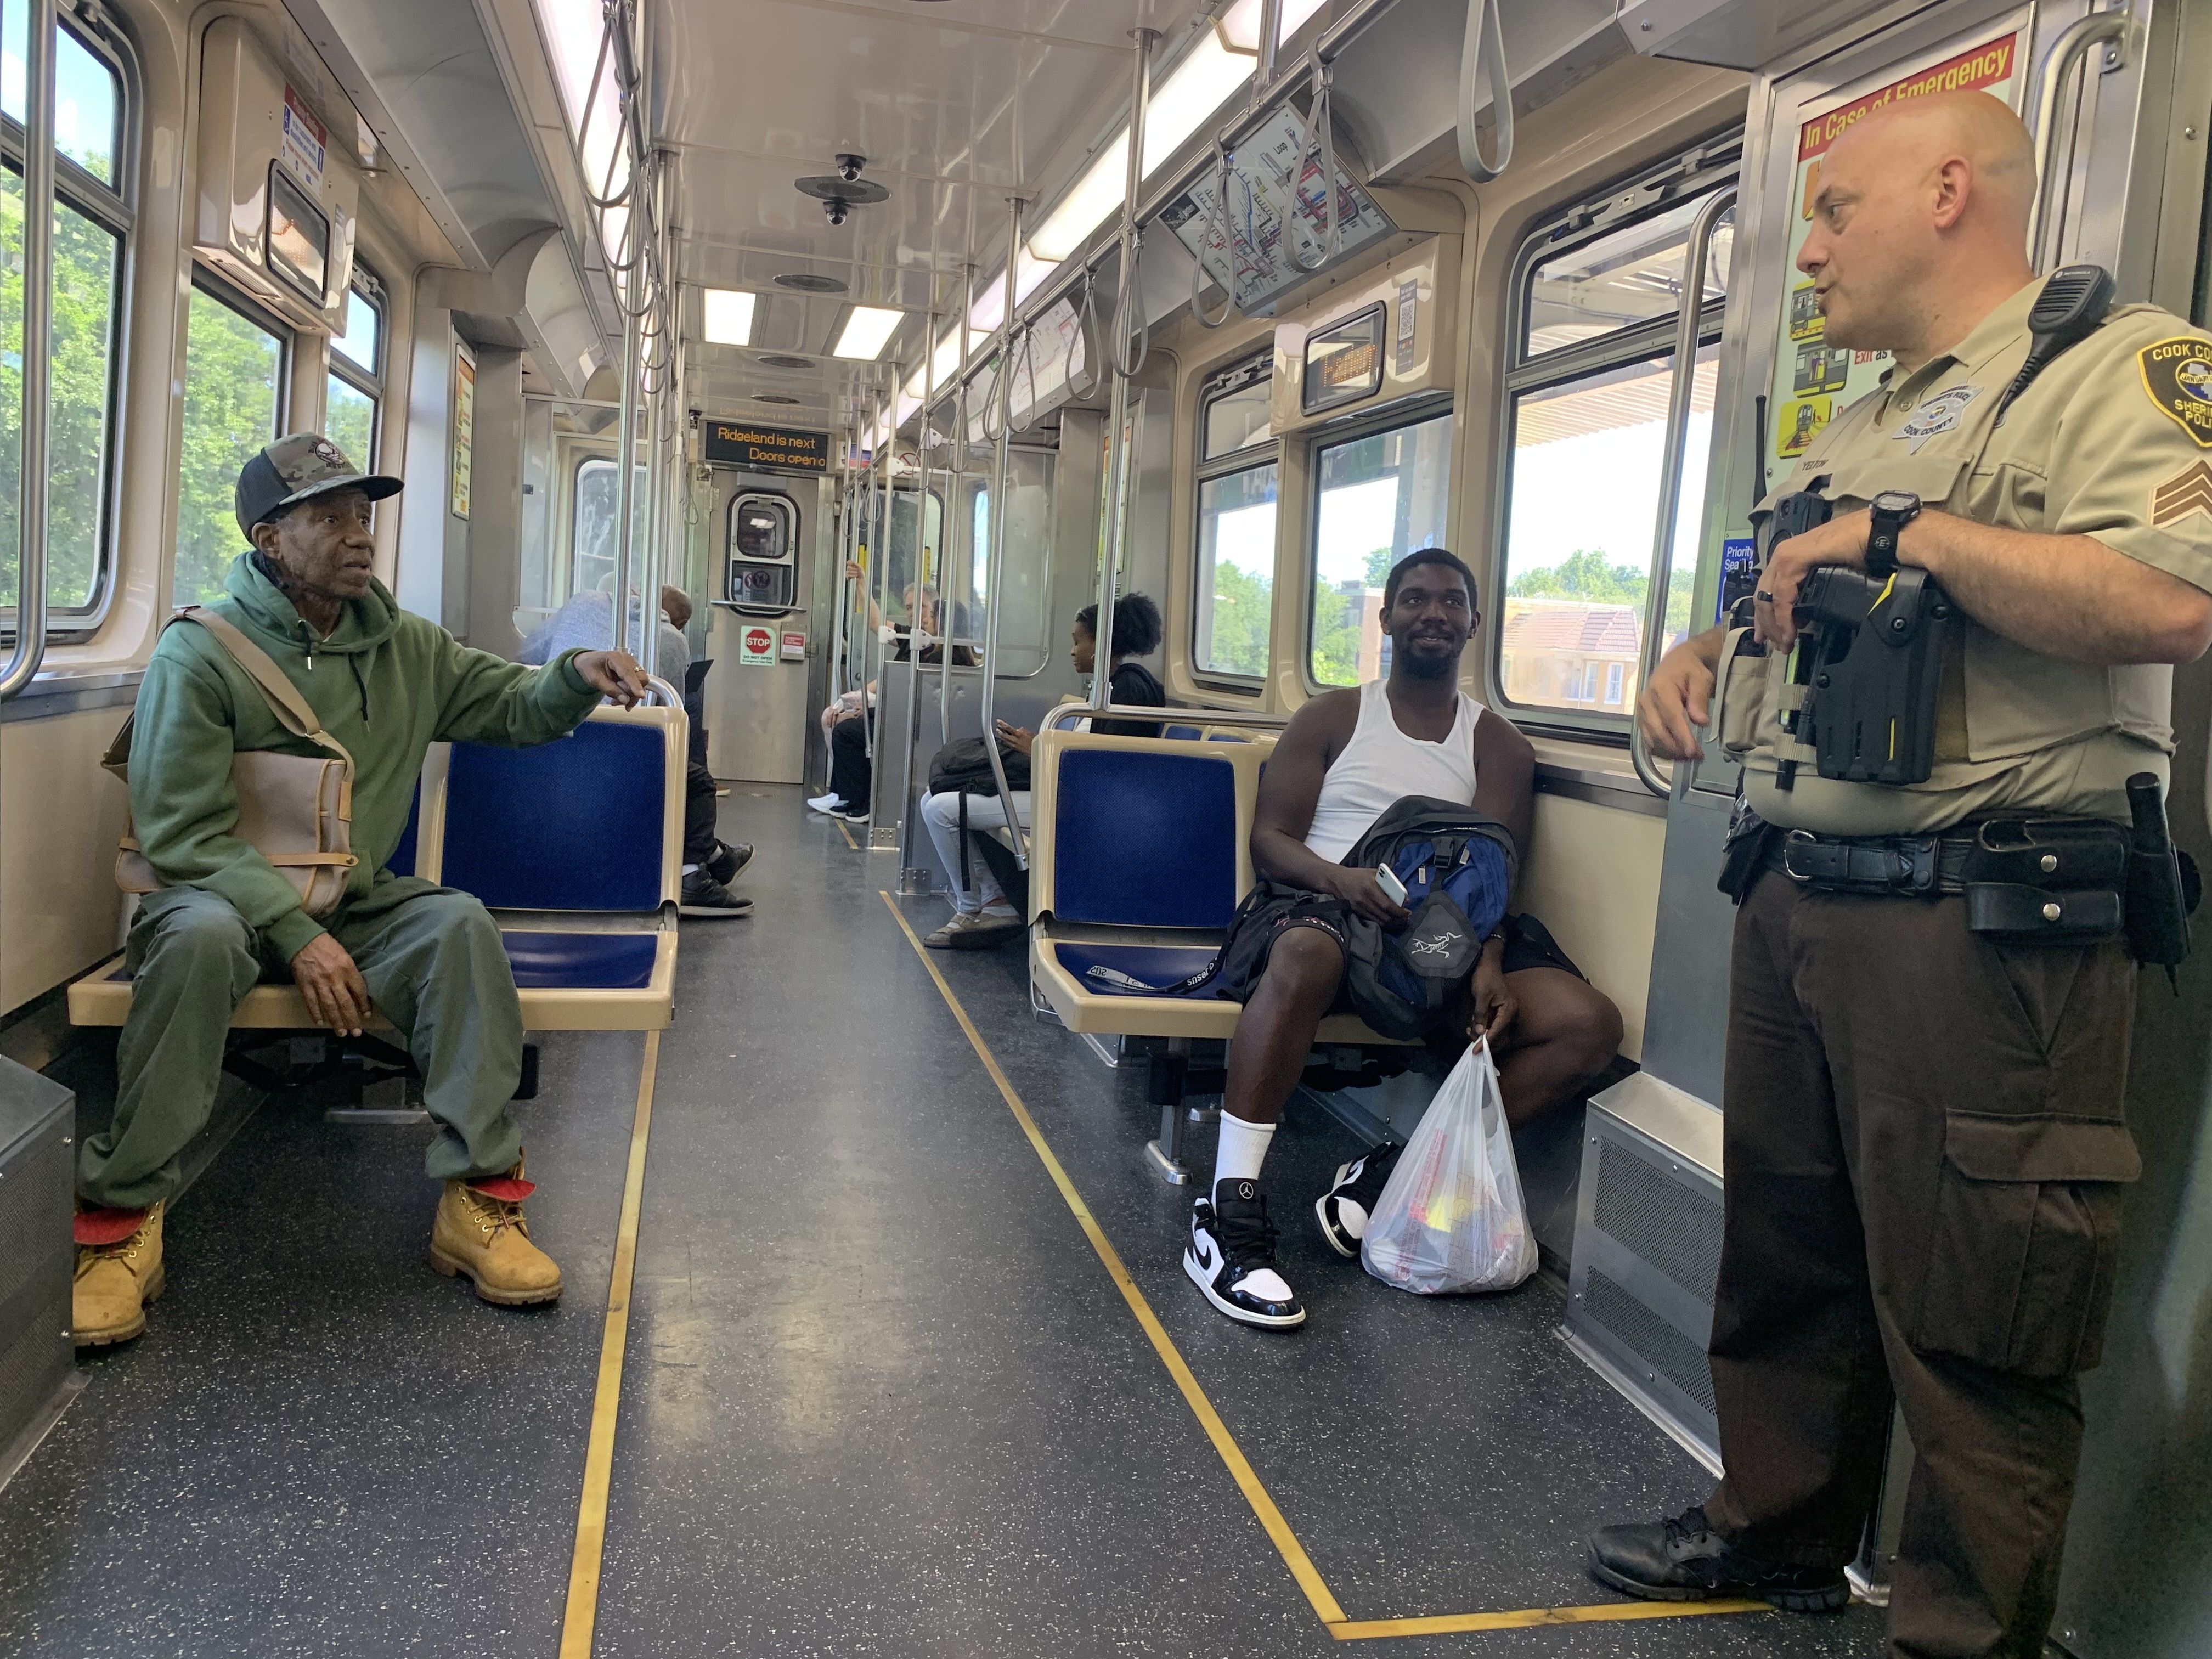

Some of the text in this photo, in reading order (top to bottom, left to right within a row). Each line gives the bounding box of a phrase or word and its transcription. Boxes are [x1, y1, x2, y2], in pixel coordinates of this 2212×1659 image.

[1805, 45, 2010, 149] In Case of Emergency
[1273, 142, 1288, 155] Loop
[1876, 350, 1887, 360] as
[2153, 344, 2191, 360] COOK
[1904, 416, 1954, 436] COOK COUNTY
[718, 427, 816, 449] Ridgeland is next
[749, 447, 786, 462] Doors
[787, 455, 816, 466] open
[1726, 546, 1754, 560] Priority
[747, 637, 770, 647] STOP
